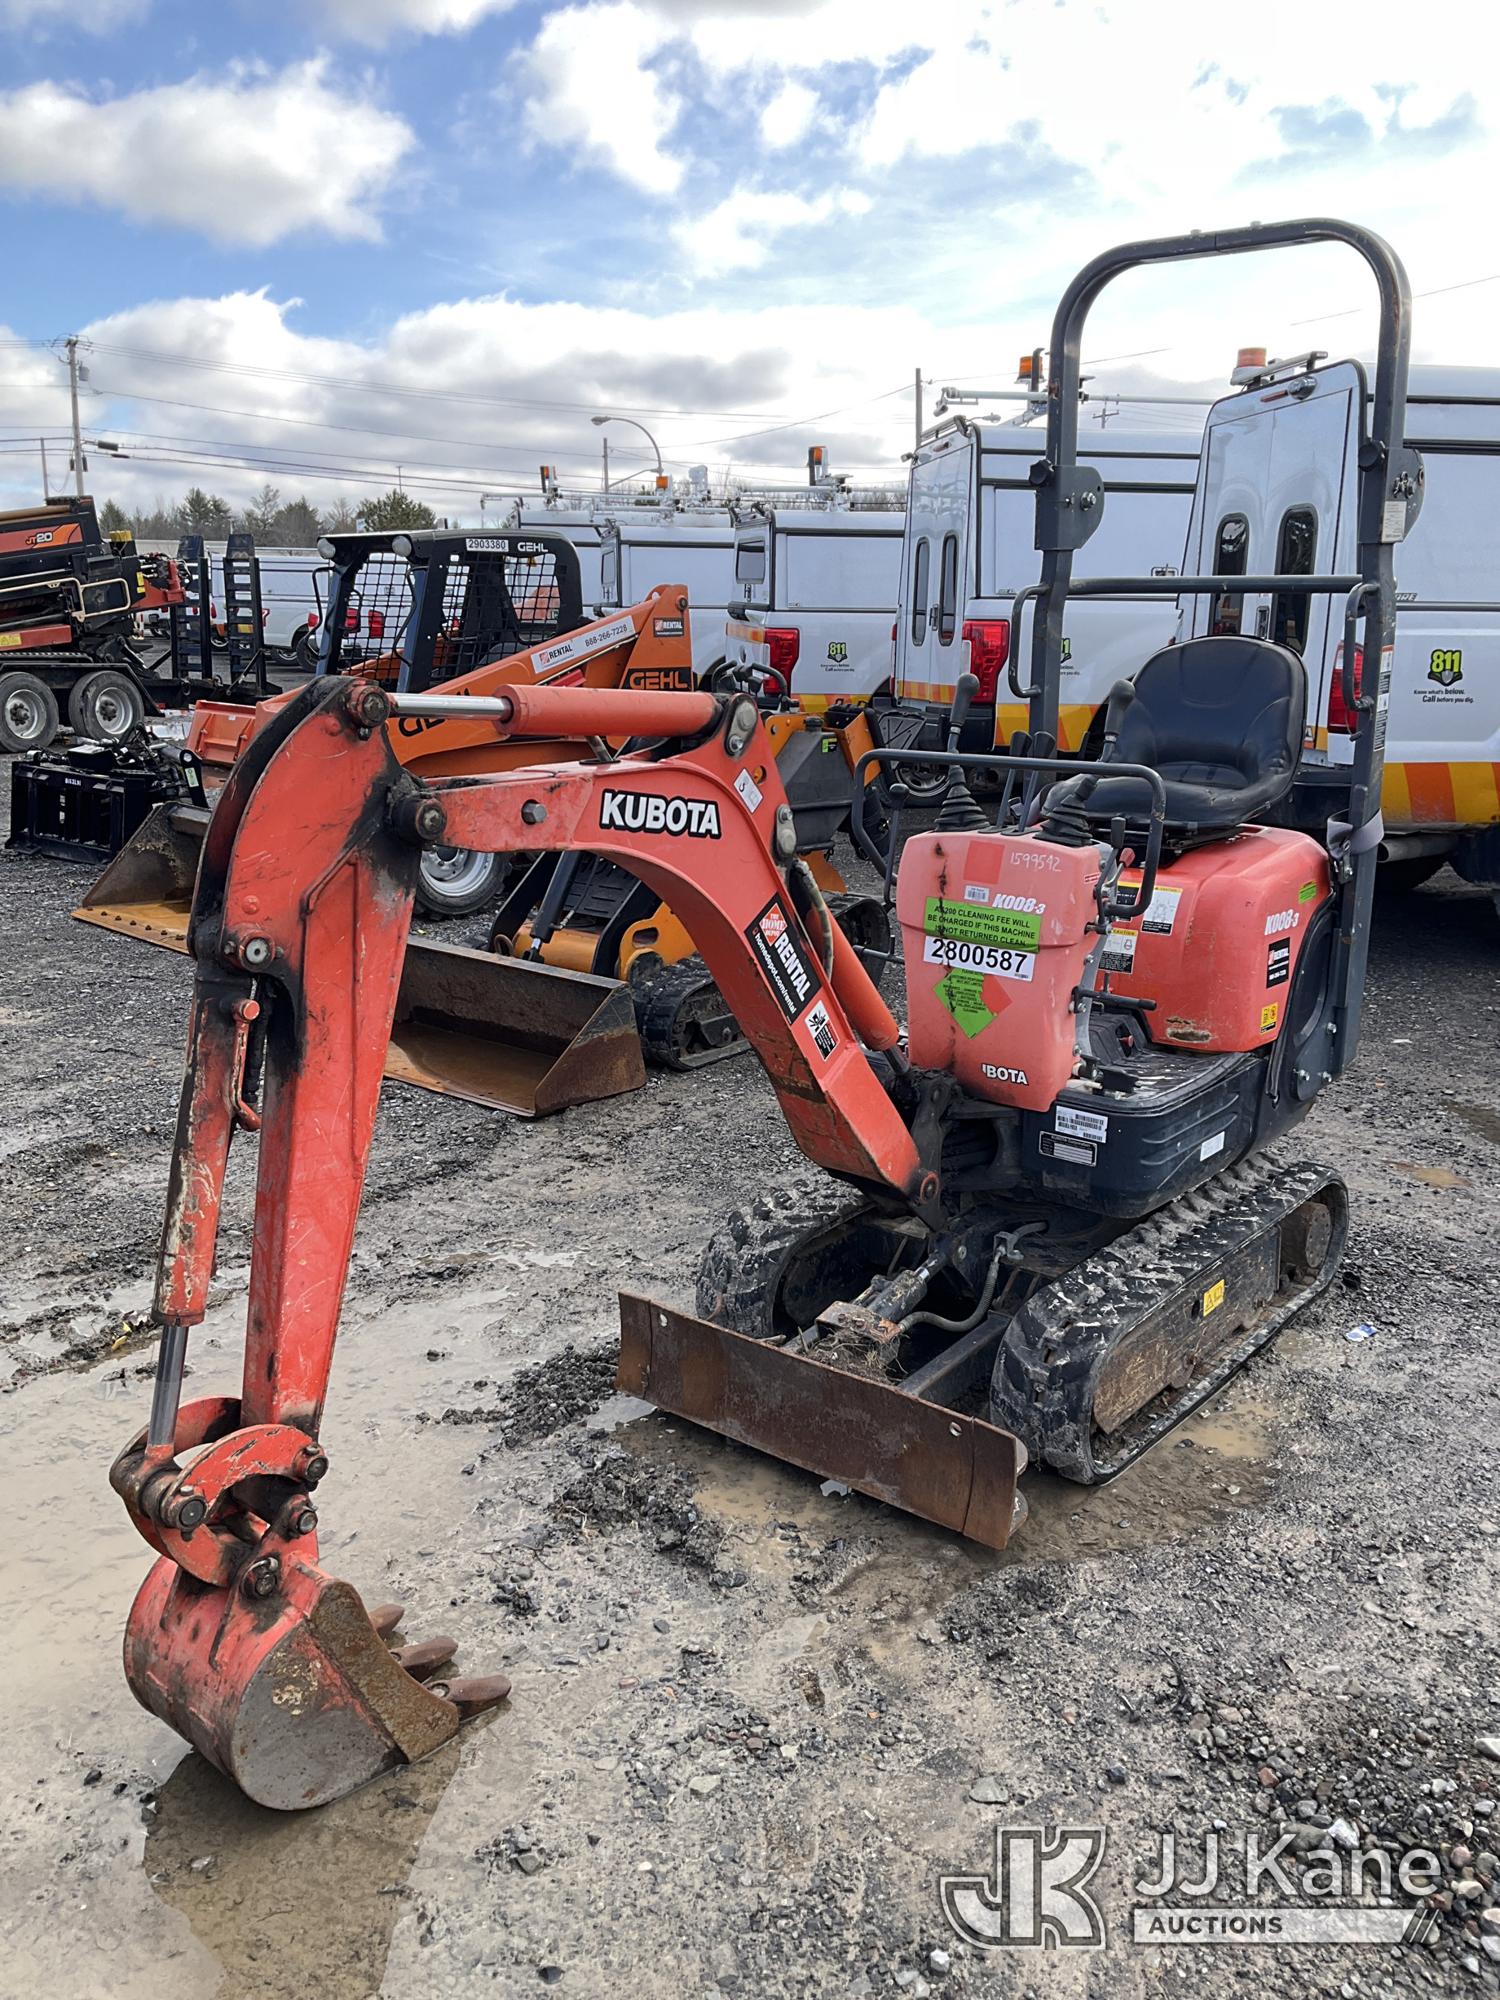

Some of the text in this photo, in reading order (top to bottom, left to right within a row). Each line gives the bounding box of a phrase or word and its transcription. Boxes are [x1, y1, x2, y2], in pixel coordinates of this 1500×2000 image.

[25, 532, 53, 545] JT20
[468, 539, 506, 550] 2903380
[517, 542, 549, 553] GEHL
[548, 644, 573, 660] RENTAL
[829, 642, 847, 657] 811
[1431, 650, 1460, 673] 811
[629, 671, 689, 690] GEHL
[1422, 695, 1437, 703] Call
[601, 791, 720, 836] KUBOTA
[992, 893, 1046, 914] K008-3
[939, 915, 974, 928] CHARGED
[984, 922, 1000, 932] THIS
[1001, 926, 1036, 939] MACHINE
[958, 909, 995, 921] CLEANING
[997, 916, 1010, 924] FEE
[1012, 918, 1030, 928] WILL
[1264, 909, 1299, 936] K008-3
[944, 926, 958, 934] NOT
[959, 928, 999, 942] RETURNED
[931, 938, 1028, 973] 2800587
[754, 932, 797, 1014] homedepot.com/rental
[774, 931, 812, 1002] RENTAL
[982, 1063, 1029, 1085] BOTA
